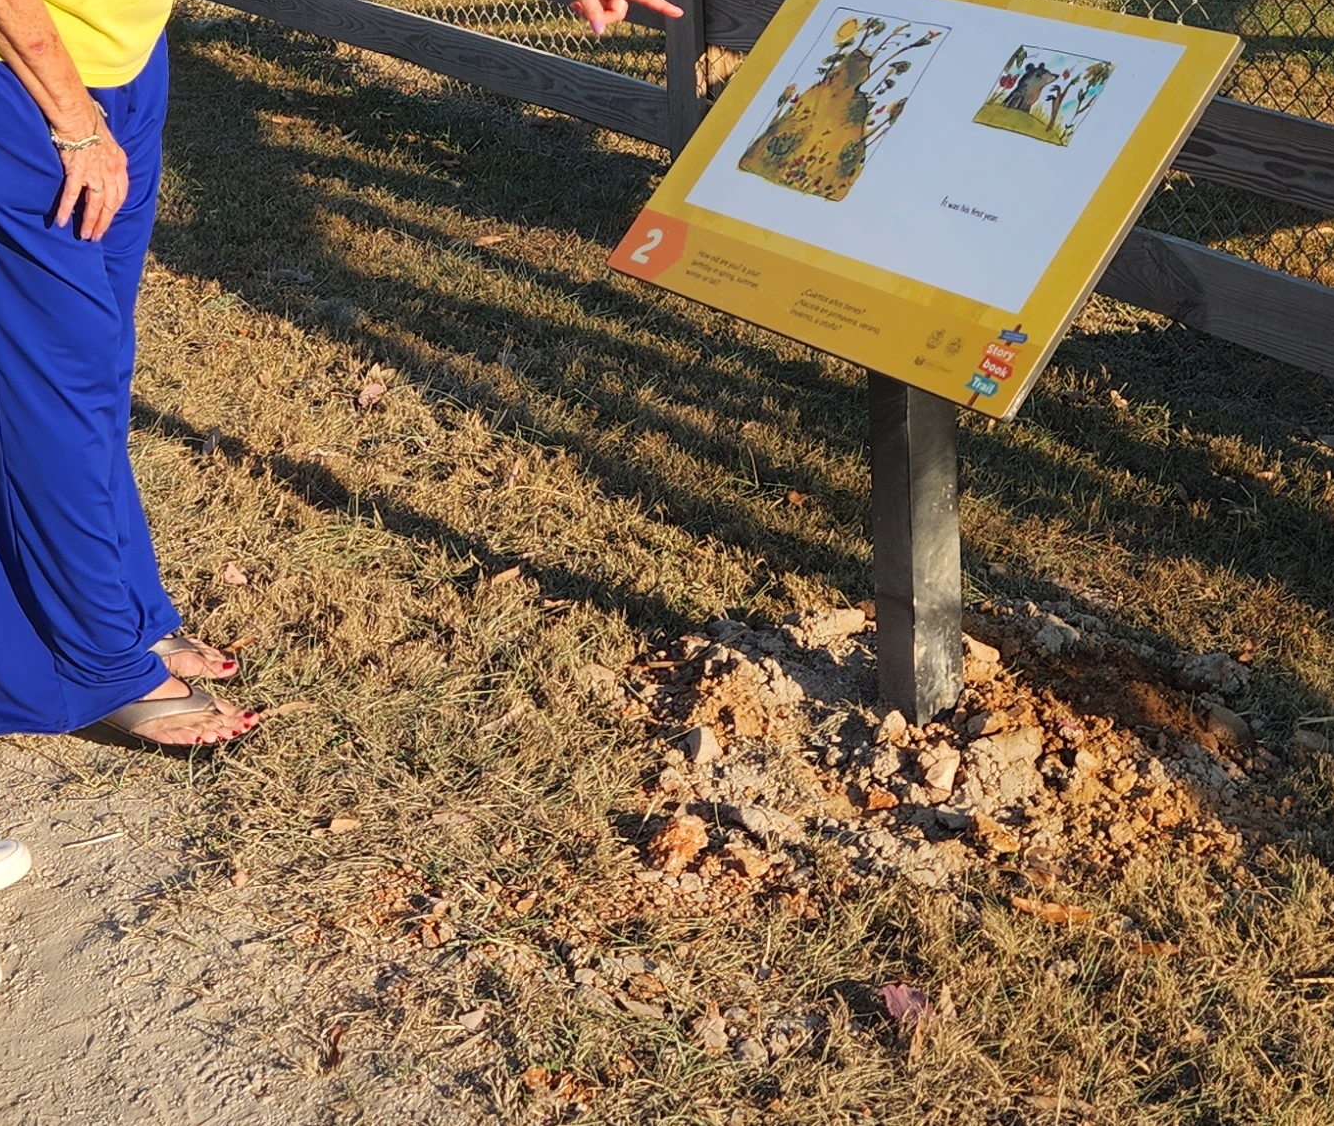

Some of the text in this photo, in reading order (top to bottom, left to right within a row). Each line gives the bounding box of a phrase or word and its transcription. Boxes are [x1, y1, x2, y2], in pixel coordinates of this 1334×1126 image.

[940, 196, 998, 222] It was his first year.
[630, 228, 663, 264] 2
[986, 343, 1015, 362] Story
[982, 358, 1008, 378] book
[972, 376, 995, 394] Trail
